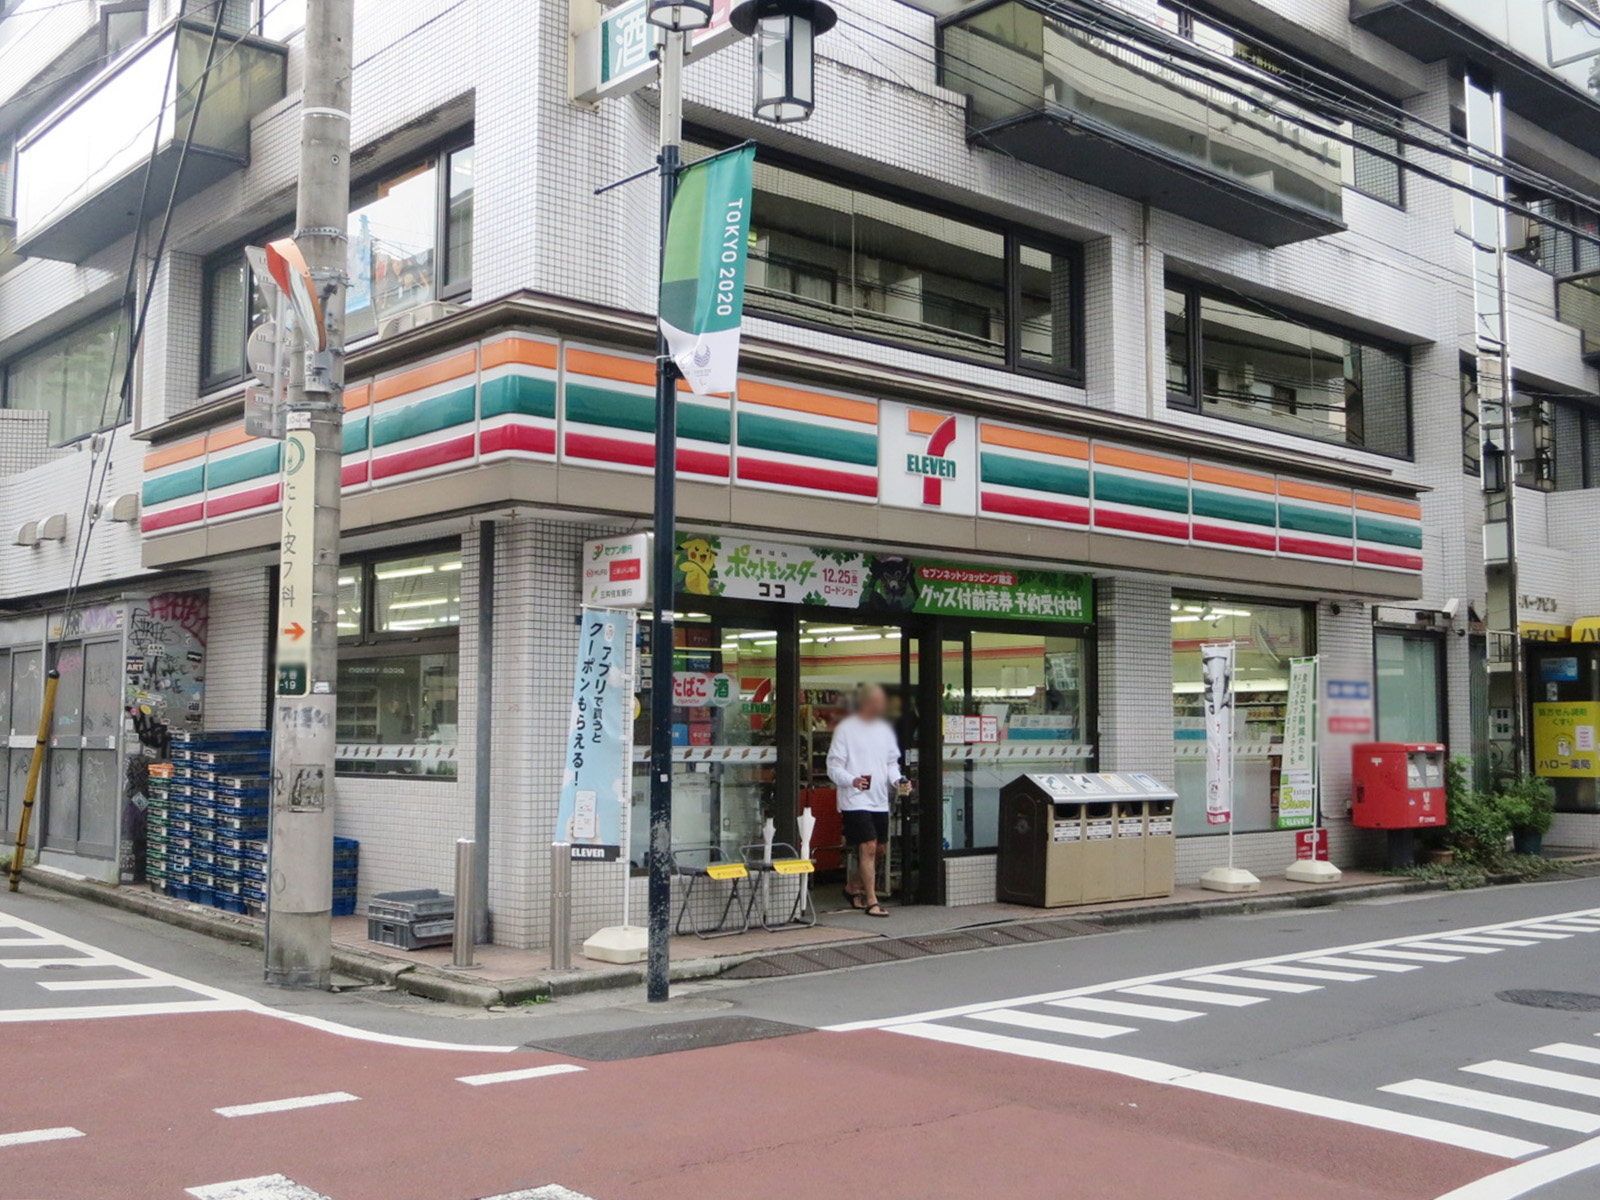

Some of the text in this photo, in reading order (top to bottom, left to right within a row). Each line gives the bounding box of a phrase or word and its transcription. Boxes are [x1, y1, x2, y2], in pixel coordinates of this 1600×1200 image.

[614, 12, 647, 73] 酒
[716, 198, 743, 317] TOKYO 2020
[724, 544, 818, 586] ポケットモンスター
[759, 582, 786, 598] ココ
[824, 585, 858, 597] ロードショー
[591, 645, 613, 744] アプリで買うと
[673, 676, 707, 697] たばこ
[713, 677, 730, 698] 酒
[1539, 759, 1592, 770] ハロー薬局
